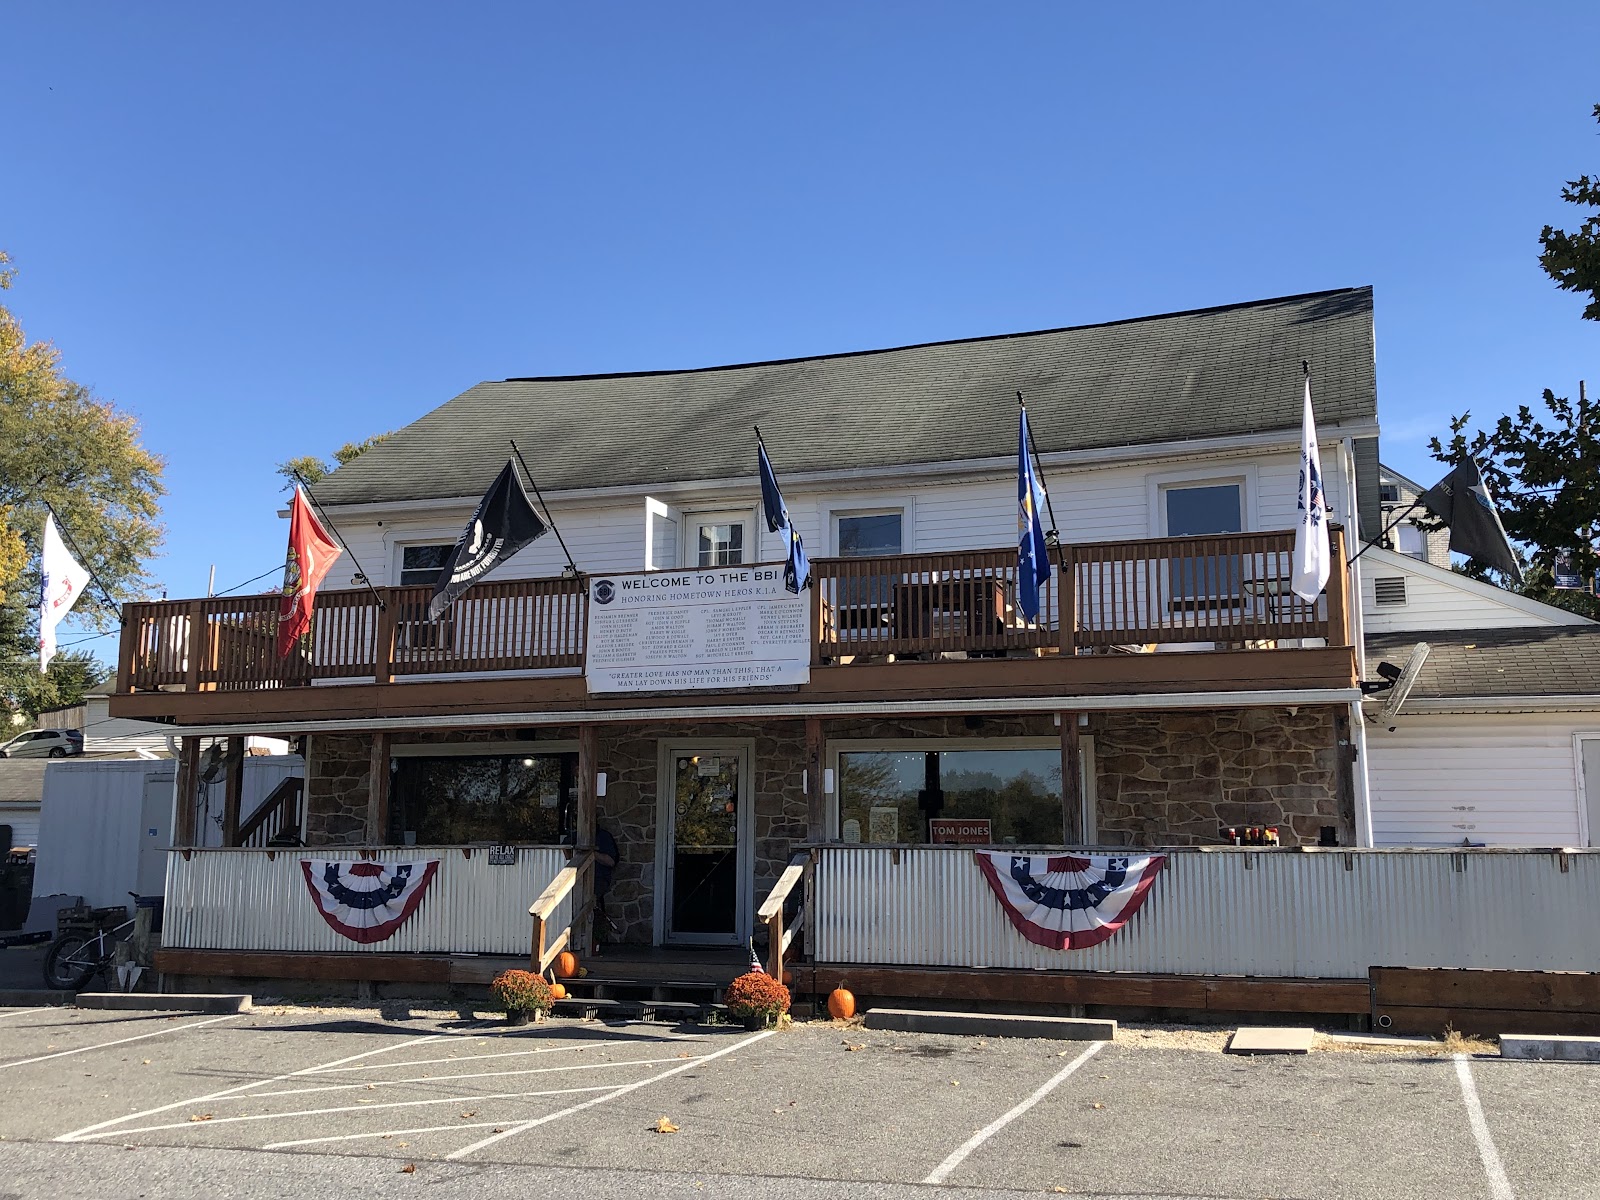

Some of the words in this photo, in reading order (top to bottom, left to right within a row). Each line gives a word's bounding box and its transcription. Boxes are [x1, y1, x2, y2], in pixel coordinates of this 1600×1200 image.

[460, 570, 471, 581] ARE
[470, 565, 483, 577] NOT
[622, 576, 690, 589] WELCOME
[696, 575, 714, 584] TO
[720, 572, 748, 583] THE
[754, 570, 777, 581] BBI
[621, 594, 667, 603] HONORING
[670, 590, 721, 600] HOMETOWN
[724, 588, 753, 597] HEROS
[932, 827, 955, 835] TOM
[958, 827, 989, 835] JONES
[490, 845, 515, 855] RELAX
